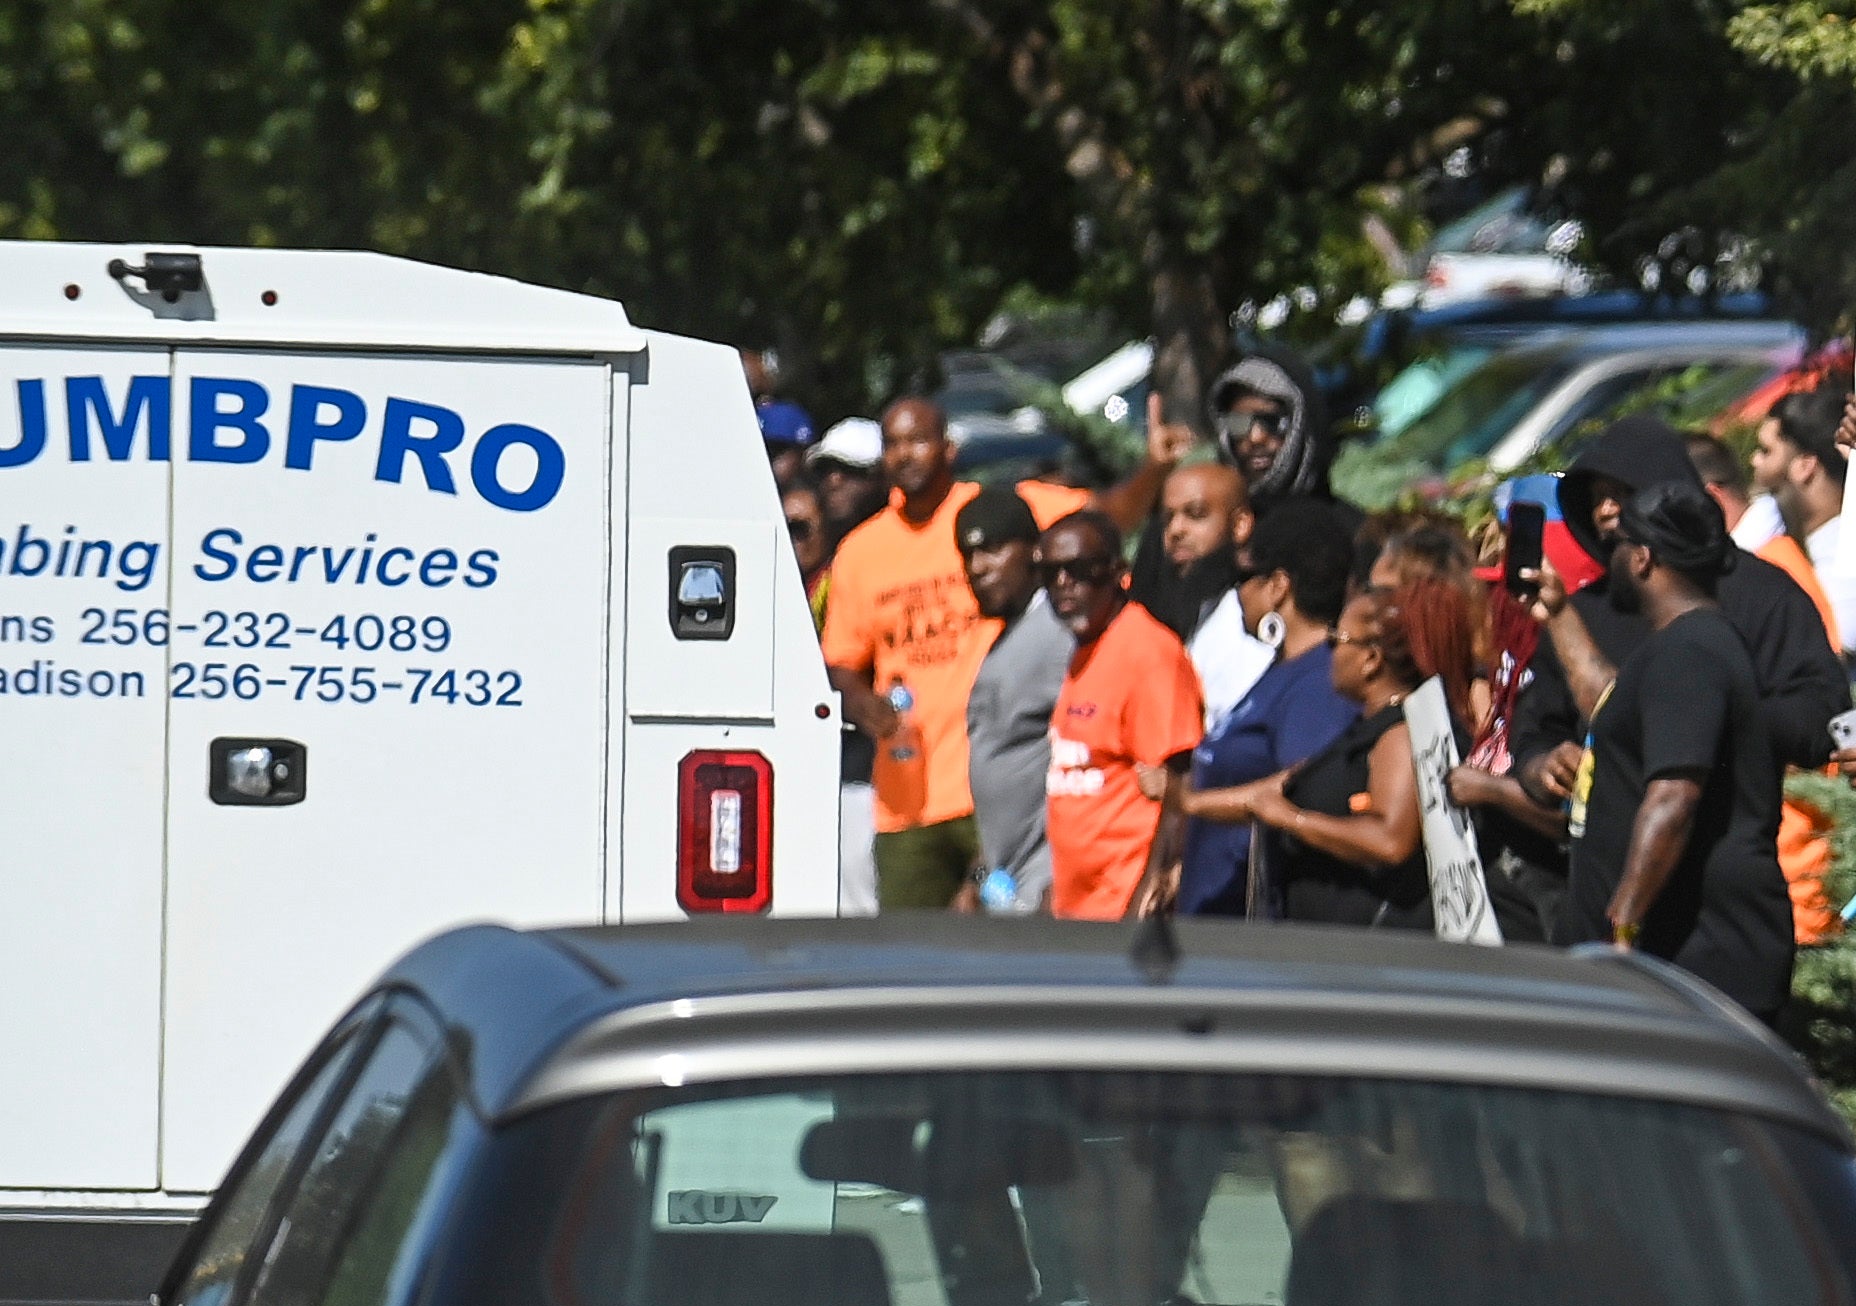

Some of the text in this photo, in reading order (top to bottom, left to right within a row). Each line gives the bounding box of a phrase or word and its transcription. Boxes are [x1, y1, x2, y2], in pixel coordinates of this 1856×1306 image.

[0, 524, 500, 591] bing Services
[80, 606, 452, 653] 256-232-4089
[0, 659, 523, 706] dison 256-755-7432
[668, 1189, 778, 1224] KUV
